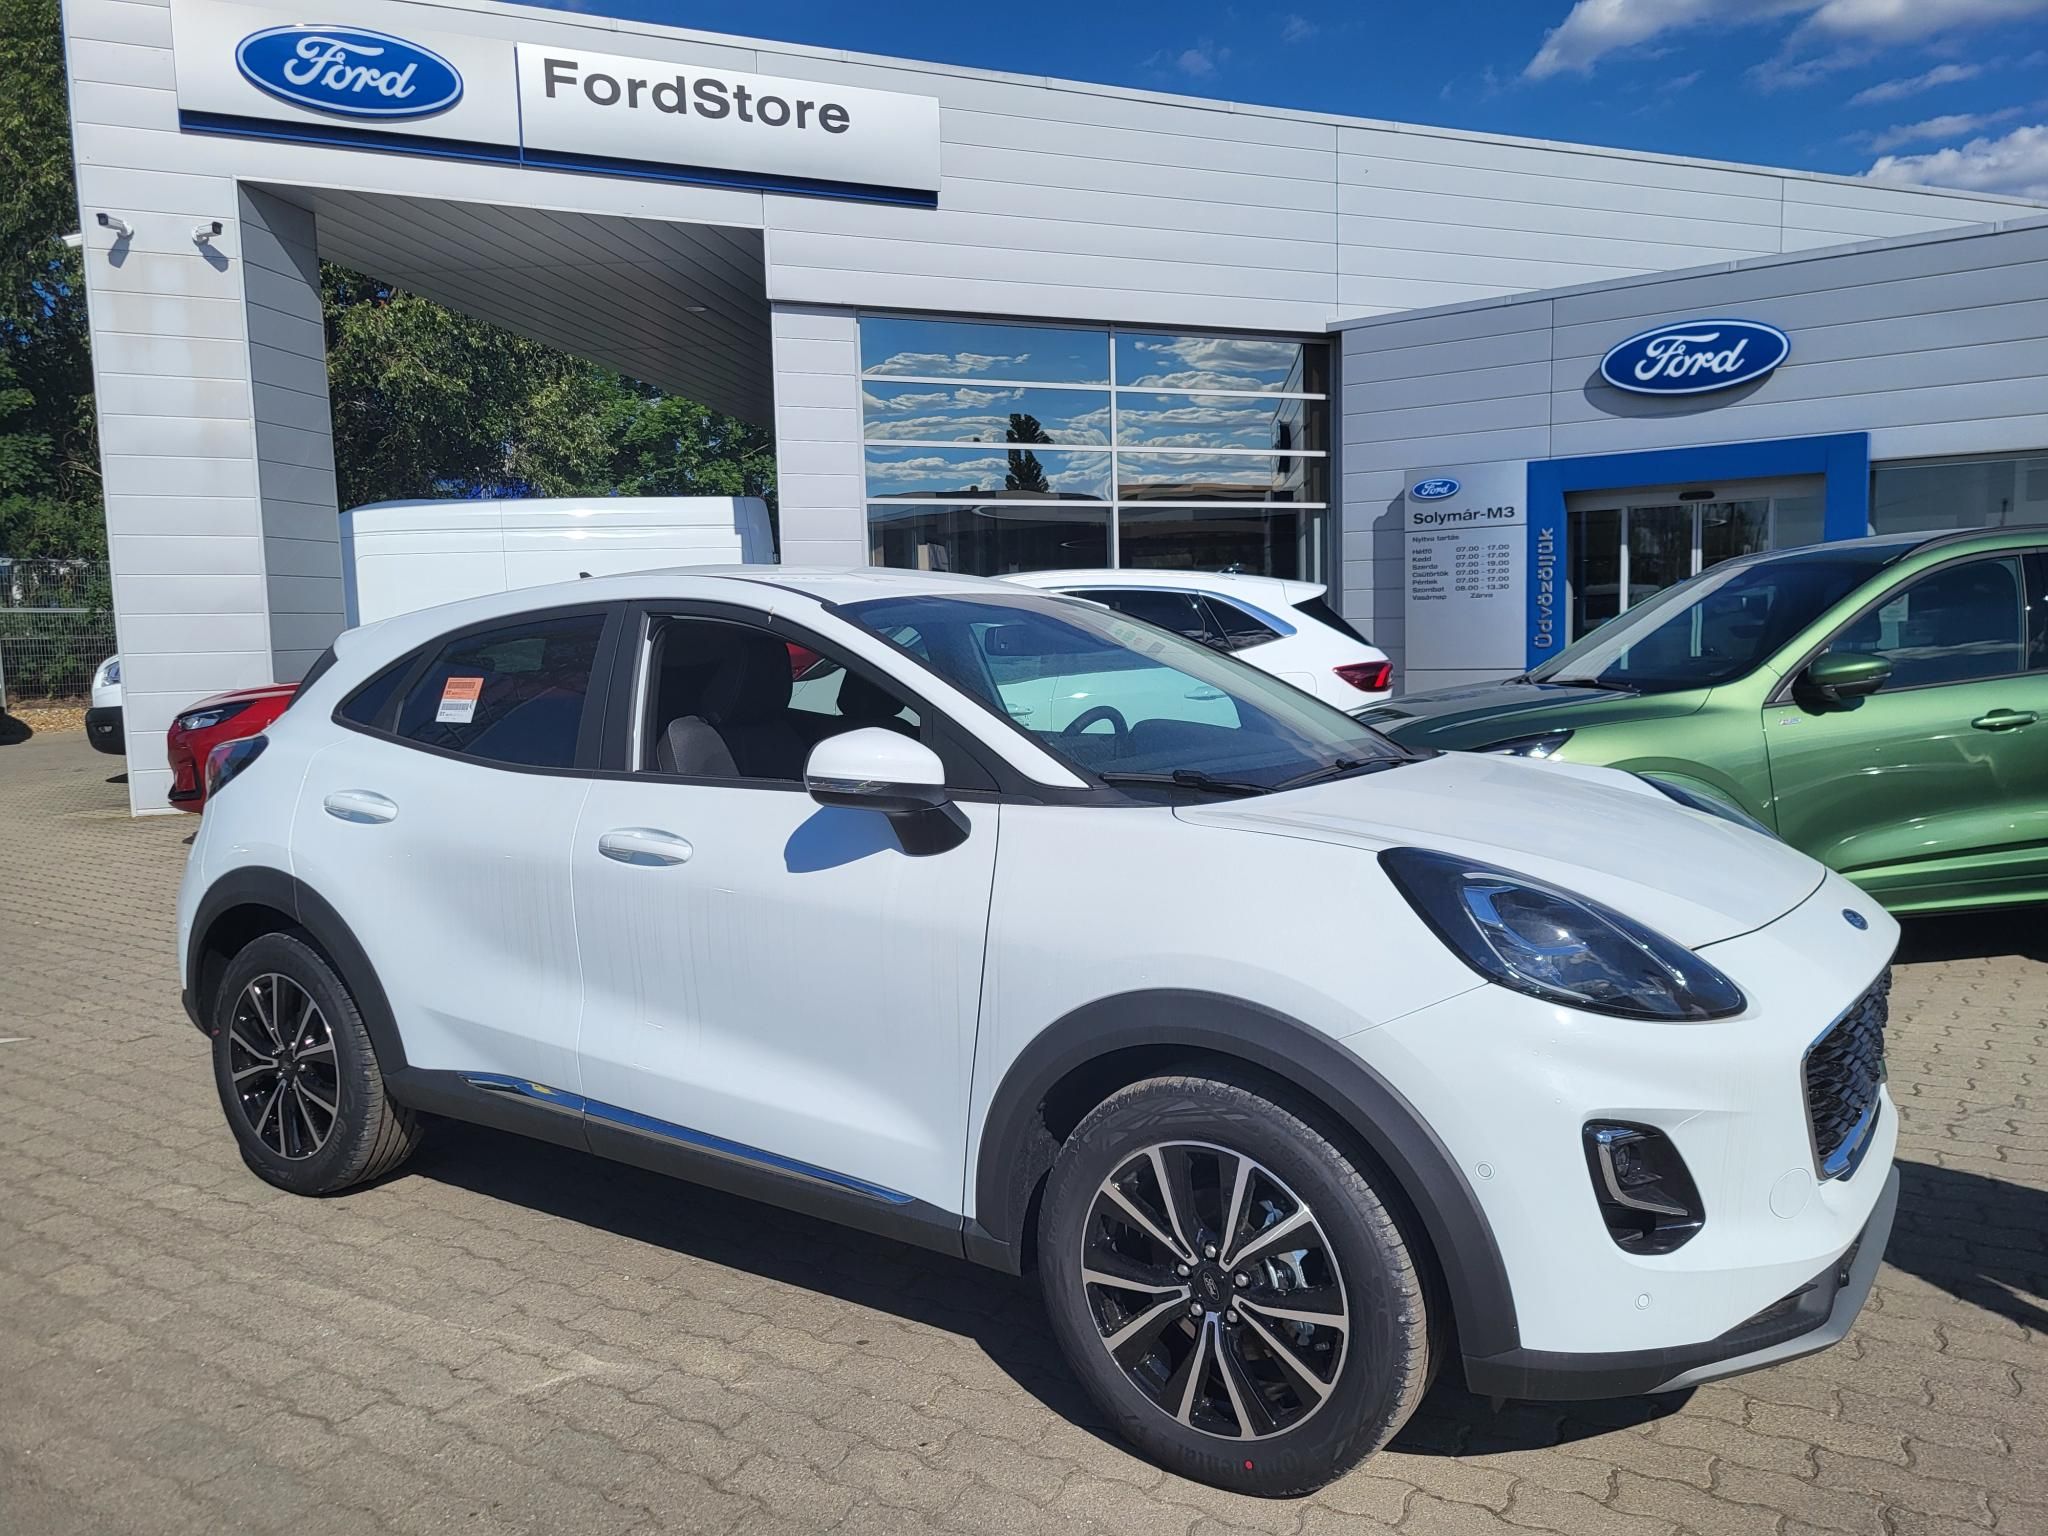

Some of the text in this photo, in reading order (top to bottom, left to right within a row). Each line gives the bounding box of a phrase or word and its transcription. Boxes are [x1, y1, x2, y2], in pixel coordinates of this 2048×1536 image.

[283, 36, 418, 98] Ford
[543, 57, 850, 134] FordStore
[1634, 332, 1749, 381] Ford
[1413, 506, 1516, 526] Solymár-M3
[1421, 481, 1450, 496] Ford
[1534, 527, 1556, 648] Üdvözöljük
